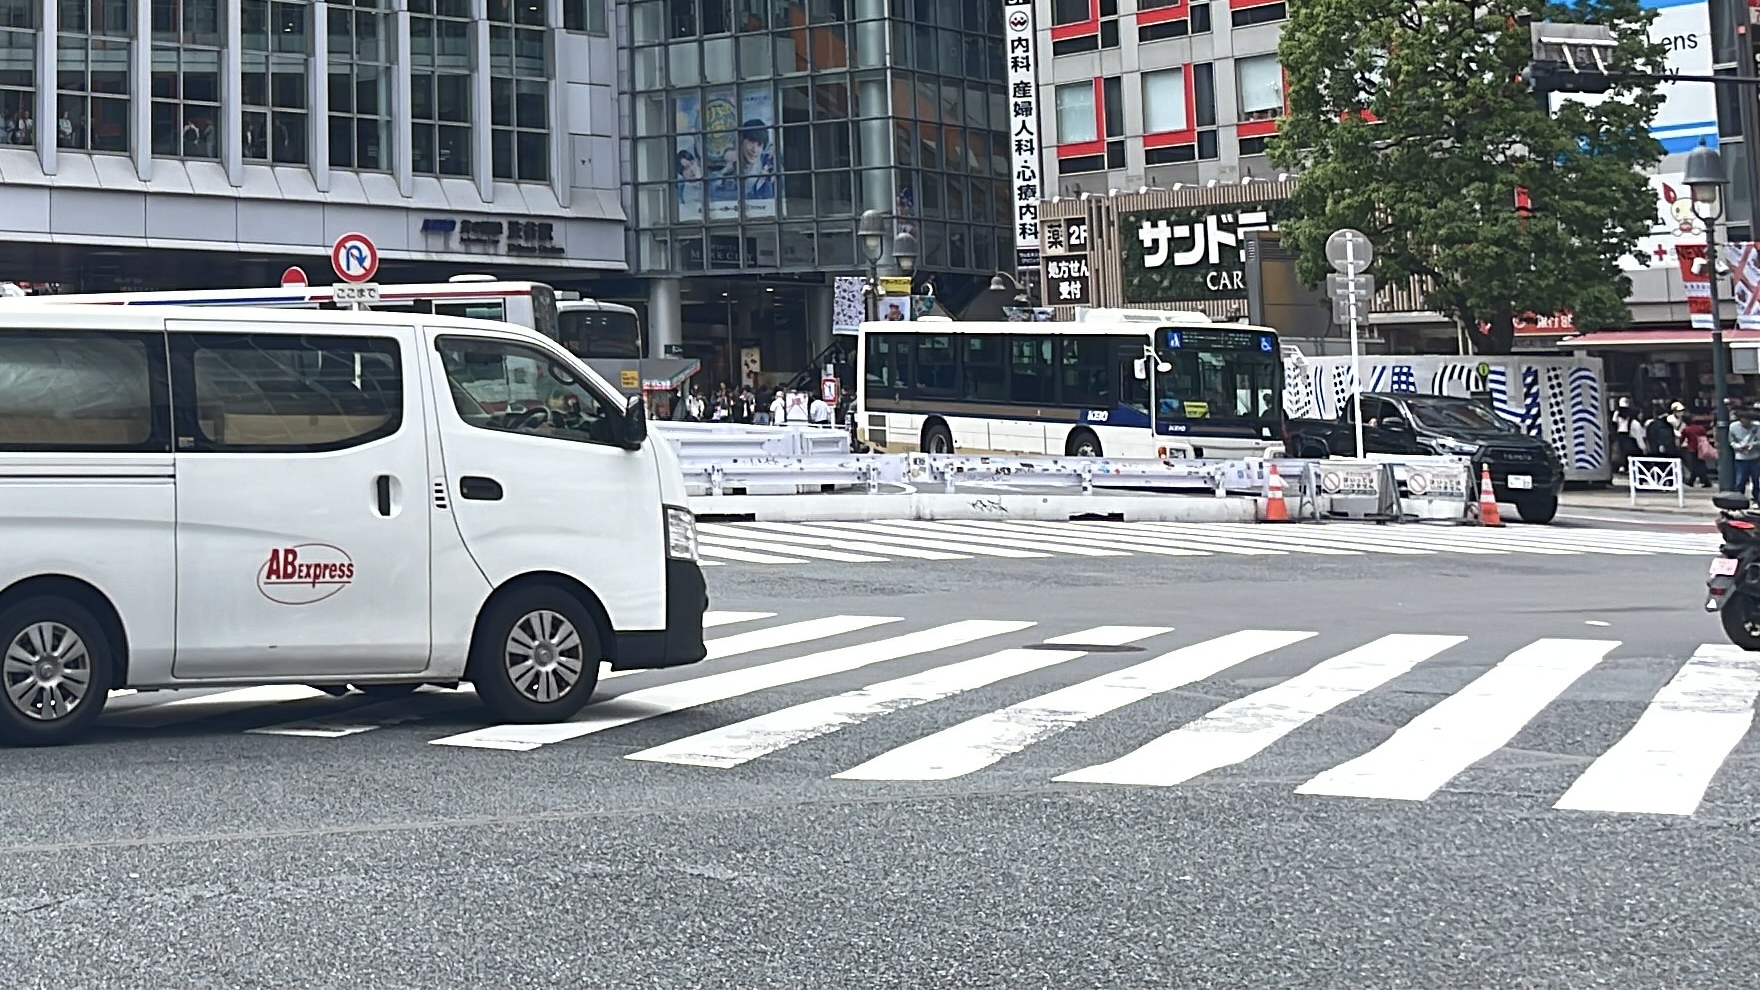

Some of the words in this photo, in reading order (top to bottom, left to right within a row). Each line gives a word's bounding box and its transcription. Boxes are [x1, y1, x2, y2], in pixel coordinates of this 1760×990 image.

[1011, 37, 1031, 74] 内科
[1012, 80, 1039, 240] 産婦人科・心療内科
[1047, 223, 1063, 250] 薬
[1069, 225, 1087, 245] 2F
[1048, 260, 1089, 279] 処方せん
[1059, 281, 1082, 300] 受付
[1206, 270, 1244, 291] CAR
[336, 288, 376, 299] ここまで
